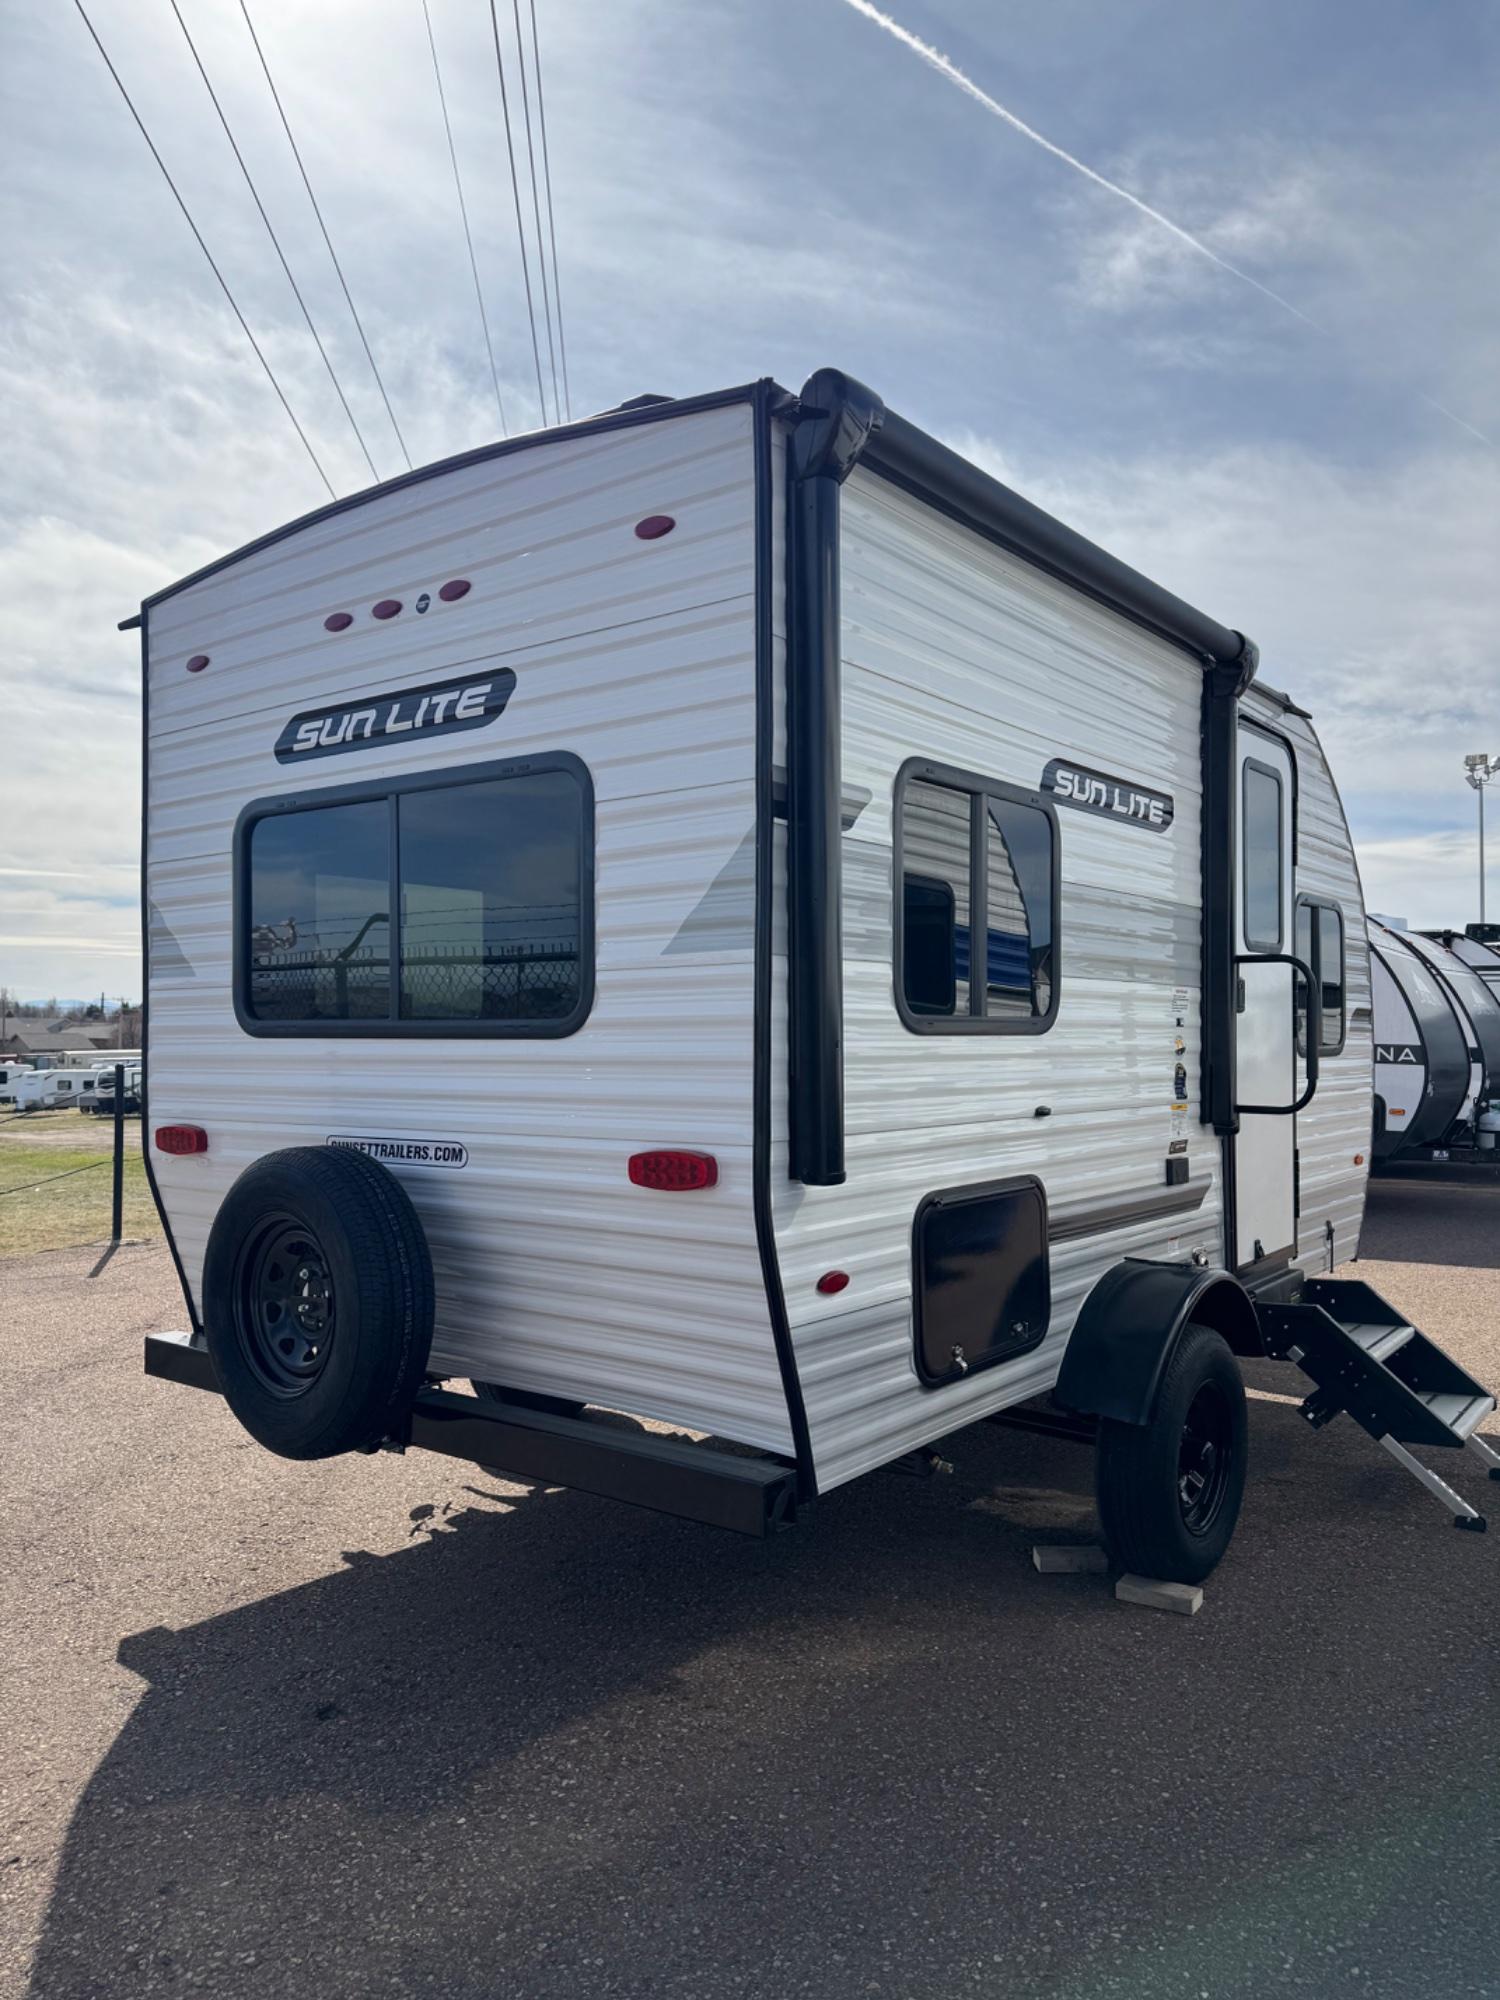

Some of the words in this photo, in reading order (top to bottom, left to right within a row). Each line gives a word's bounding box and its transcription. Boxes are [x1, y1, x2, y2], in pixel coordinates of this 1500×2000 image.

[293, 709, 377, 751] SUN
[385, 684, 492, 733] LITE
[1053, 769, 1107, 807] SUN
[1112, 788, 1164, 824] LITE
